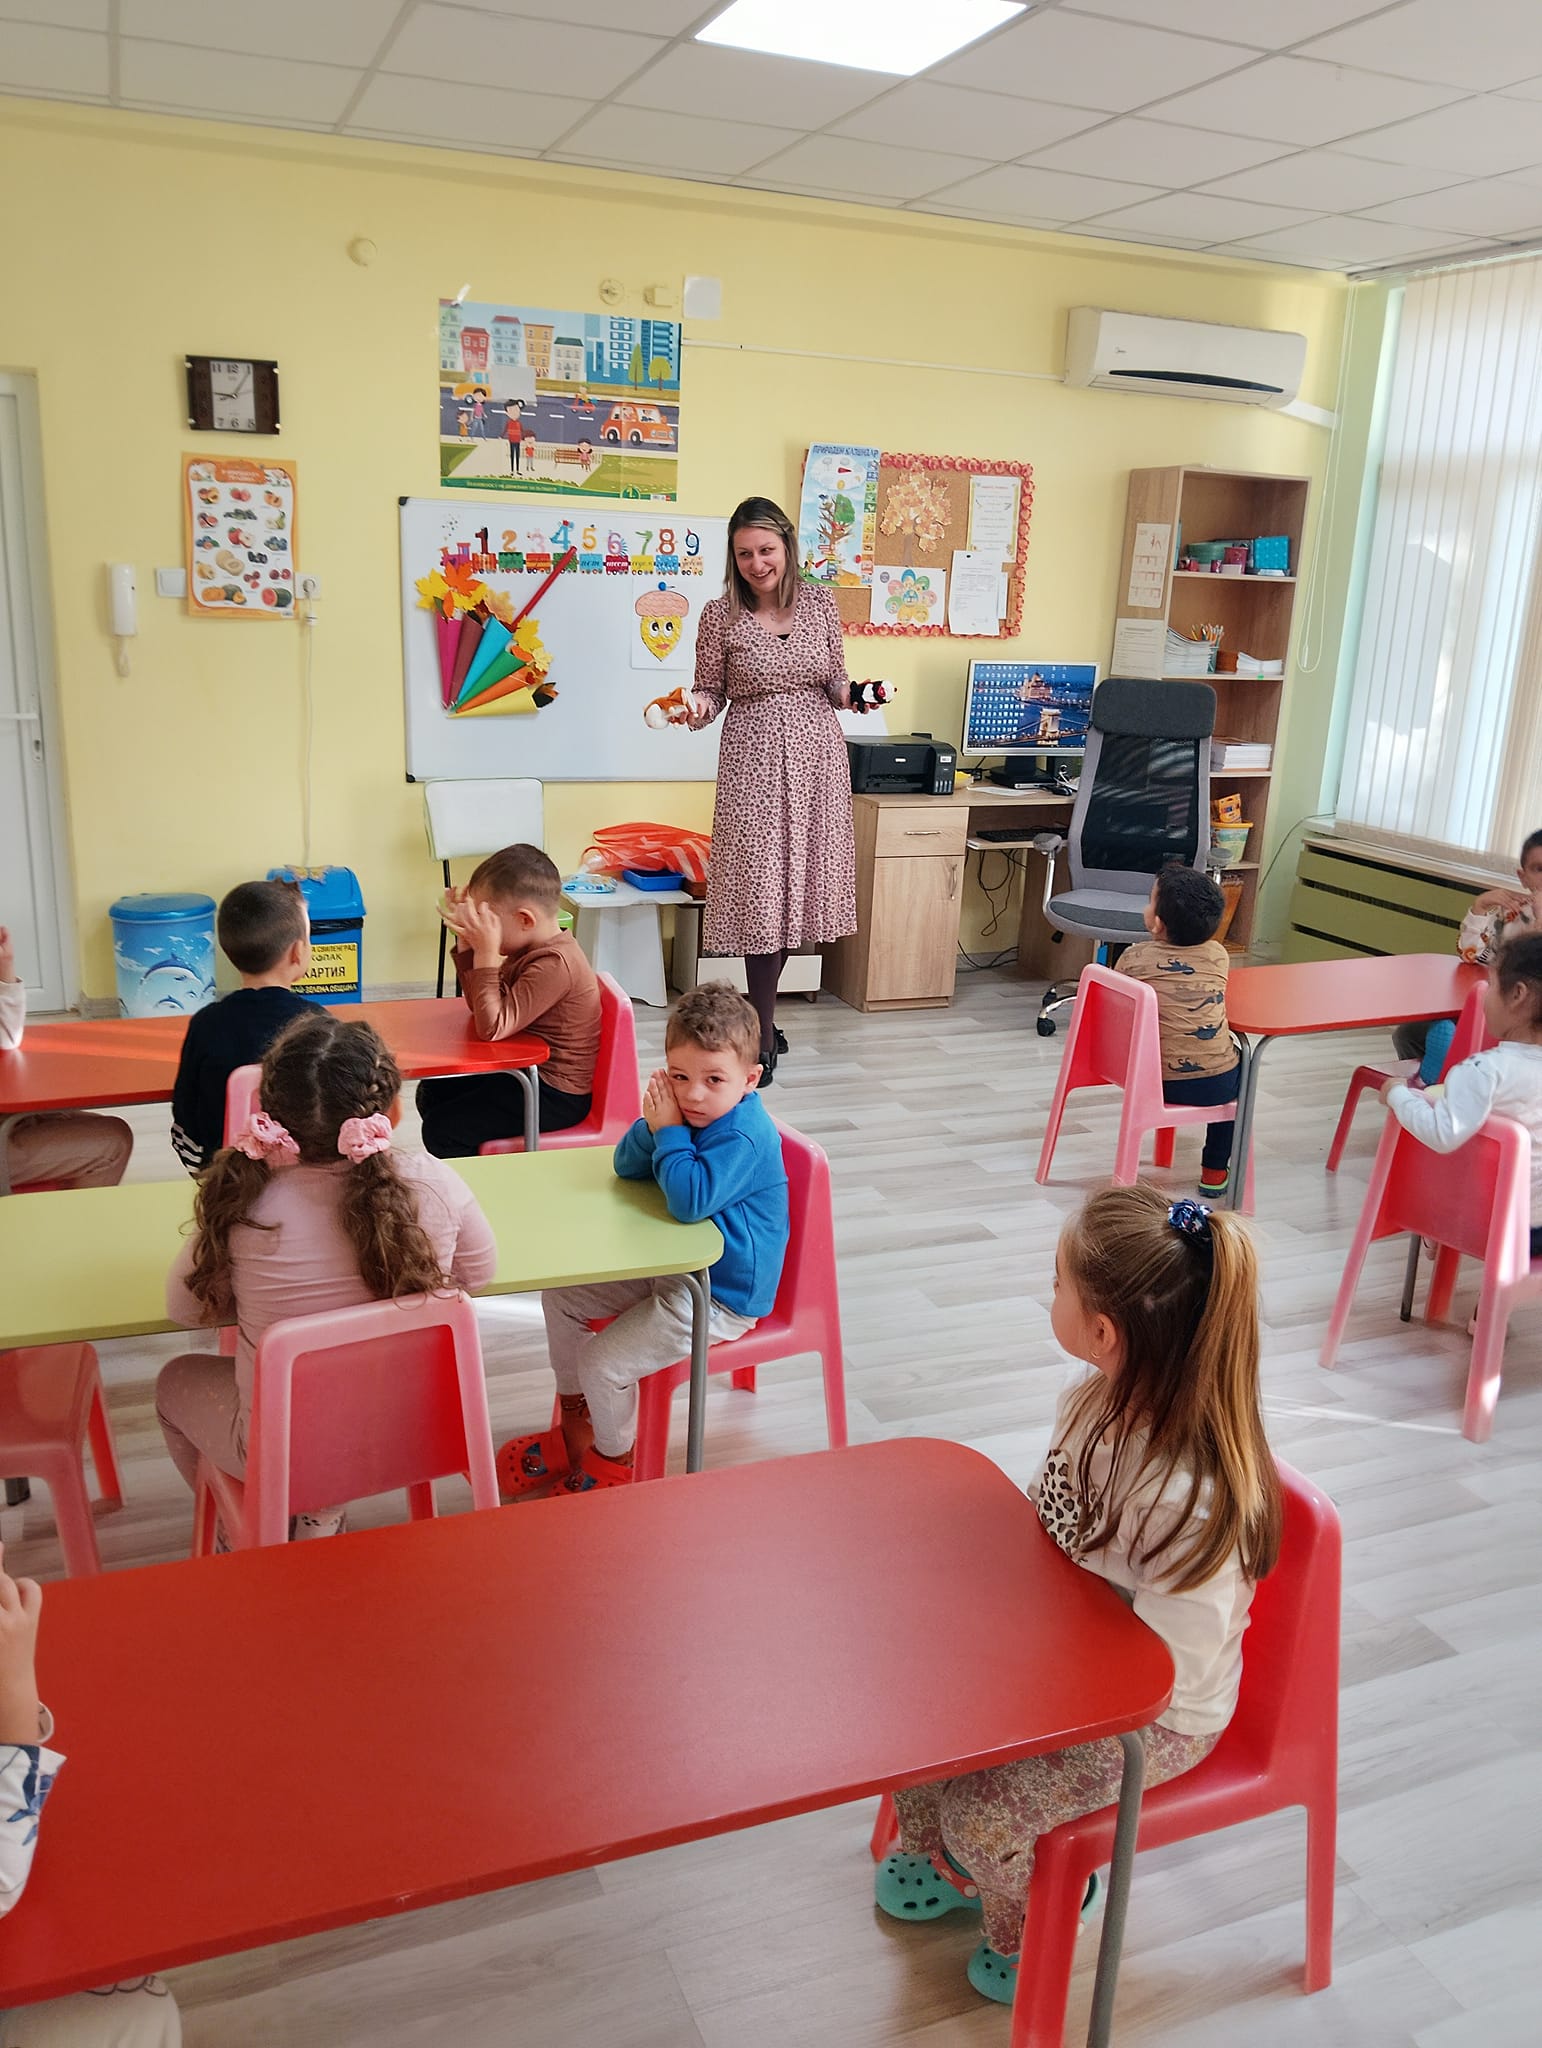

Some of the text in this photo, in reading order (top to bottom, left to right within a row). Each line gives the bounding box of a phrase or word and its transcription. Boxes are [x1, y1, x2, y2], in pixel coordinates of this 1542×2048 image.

[226, 363, 239, 374] 12
[217, 417, 225, 427] 7
[231, 418, 240, 428] 6
[475, 521, 700, 556] 1 2 3 4 5 6 7 8 9
[317, 945, 356, 953] СВИЛЕНГРАД
[329, 983, 358, 993] ОБЩИНА
